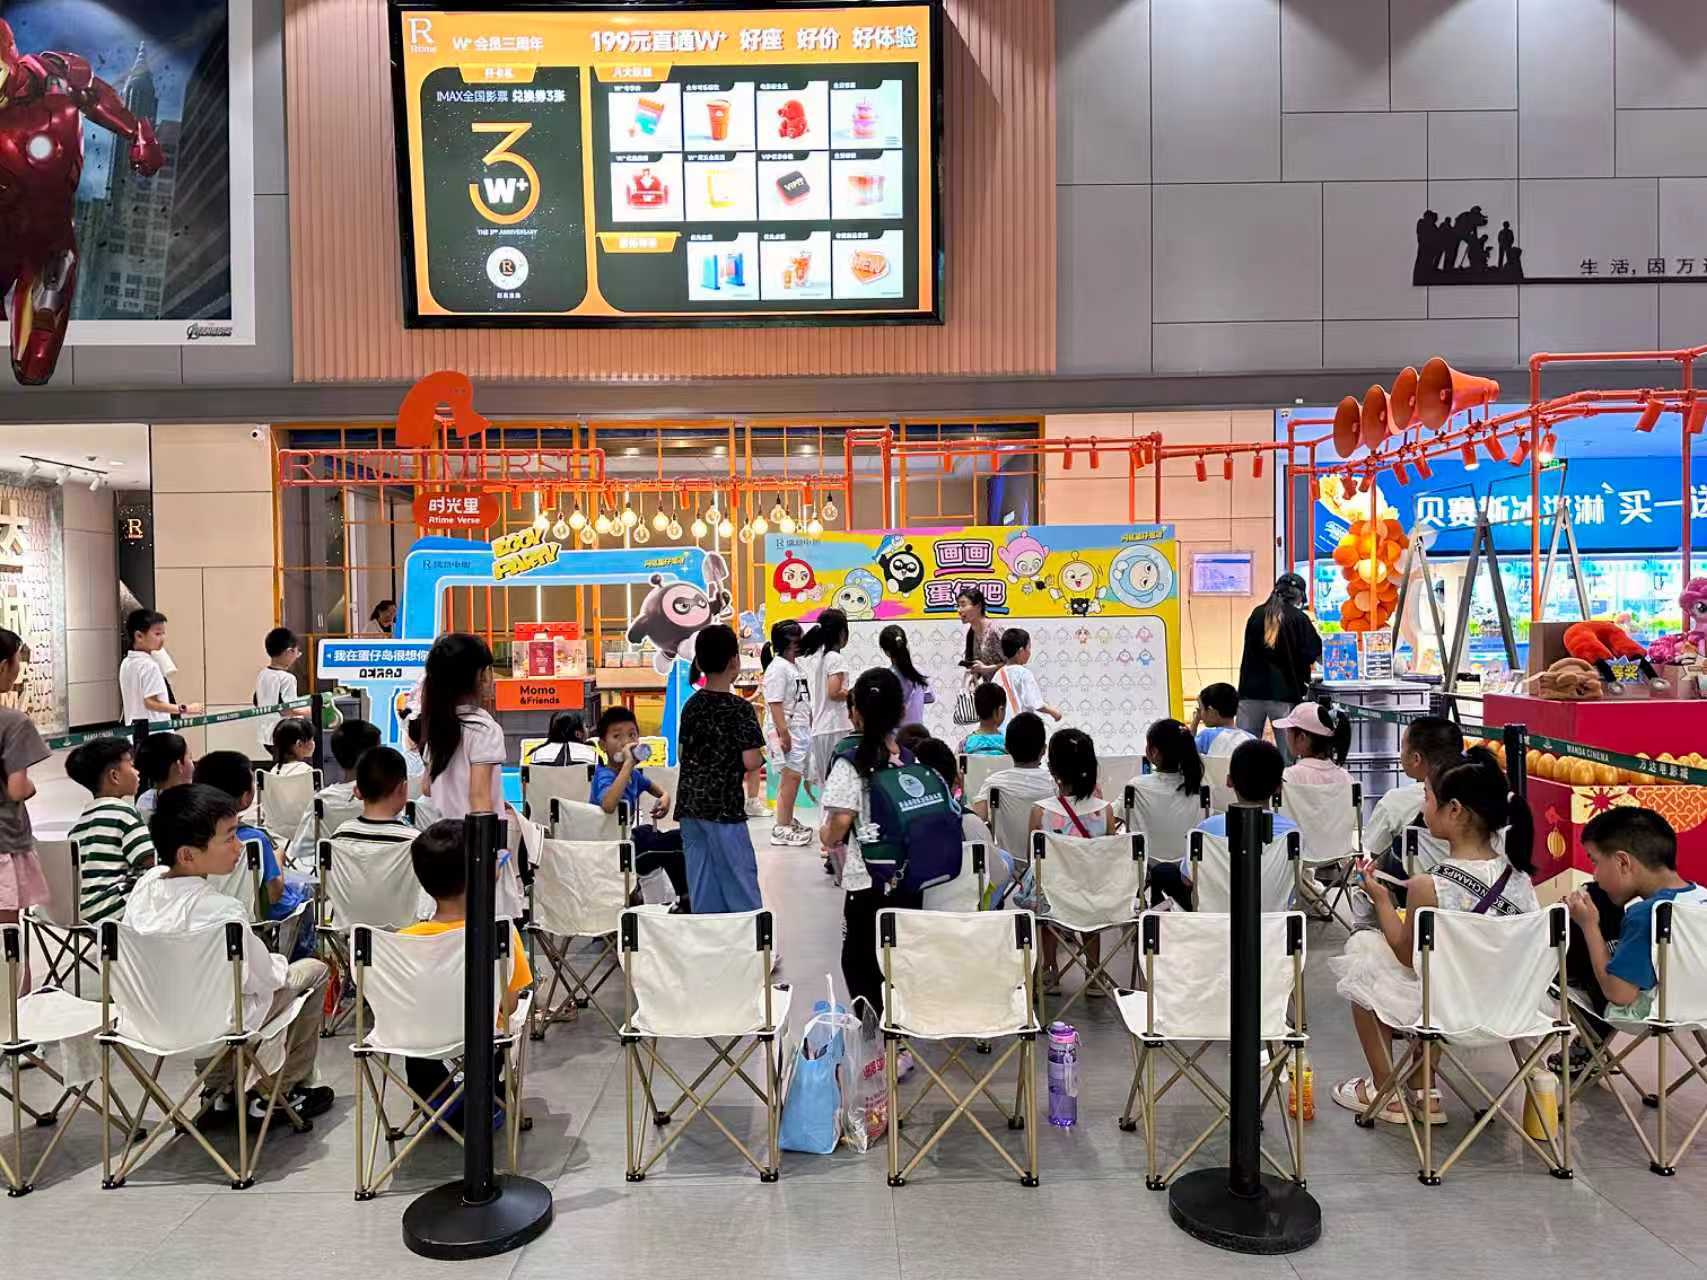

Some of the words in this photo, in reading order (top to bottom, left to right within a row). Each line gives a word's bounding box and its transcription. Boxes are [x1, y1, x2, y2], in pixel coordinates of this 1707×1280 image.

[740, 29, 784, 51] 好座
[796, 28, 839, 50] 好价
[852, 25, 918, 49] 好体验
[436, 91, 508, 102] IMAX全国影票
[512, 89, 565, 103] 兑换券3张
[429, 496, 480, 514] 时光里
[457, 516, 480, 524] Verse
[495, 543, 560, 580] PARTY
[936, 542, 991, 564] 画画
[520, 686, 555, 695] Momo
[520, 696, 560, 705] &Friends
[1567, 743, 1585, 756] WANDA
[1586, 748, 1609, 761] CINEMA
